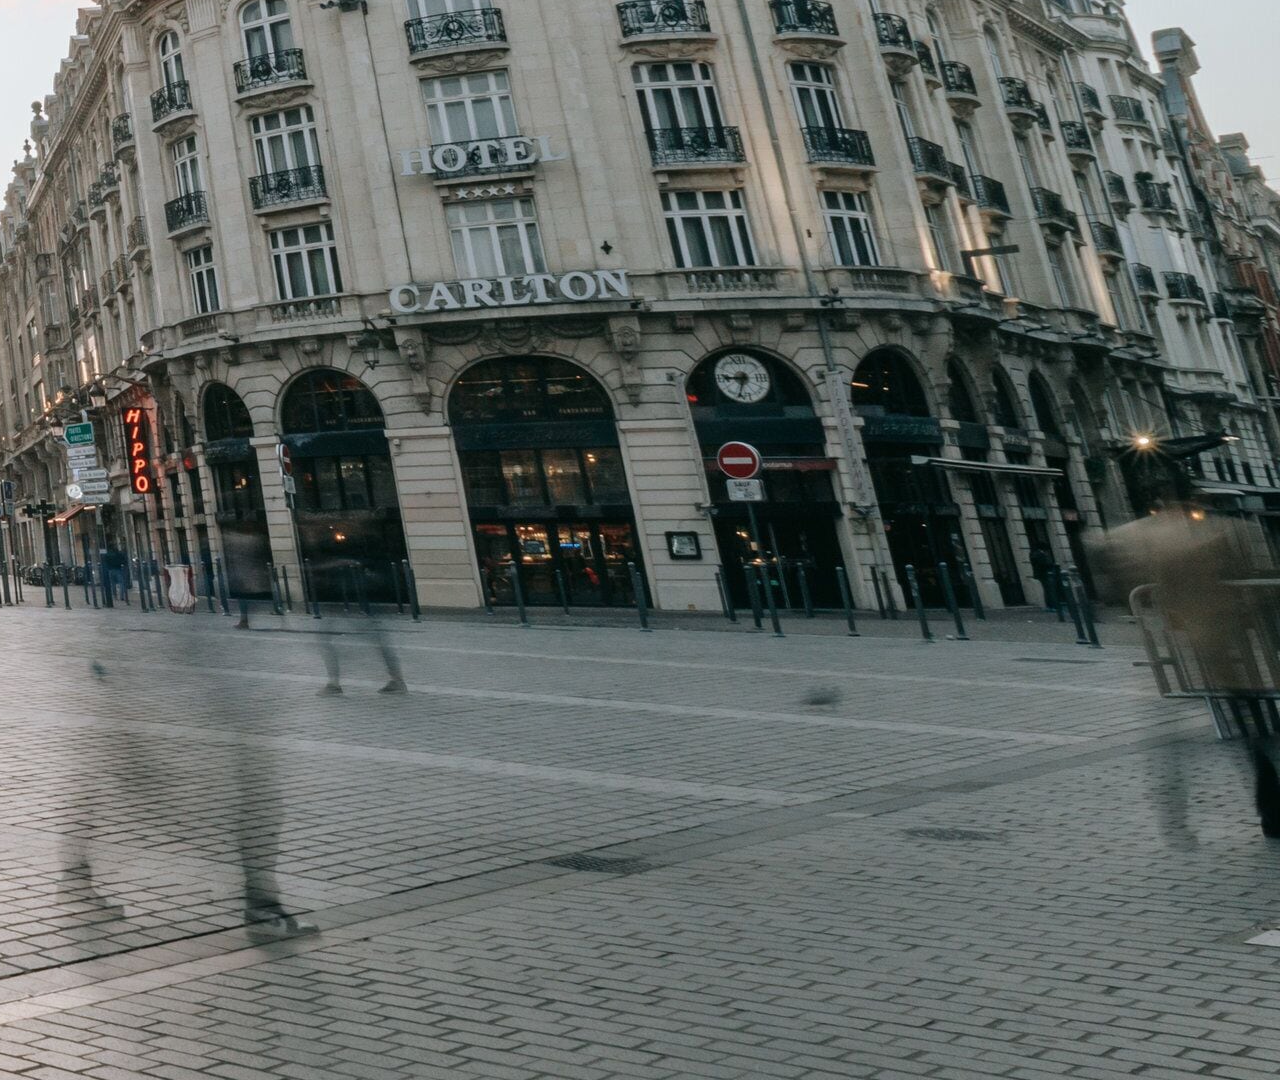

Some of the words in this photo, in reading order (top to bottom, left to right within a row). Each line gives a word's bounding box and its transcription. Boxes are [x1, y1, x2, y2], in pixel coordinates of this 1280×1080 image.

[400, 135, 567, 176] HOTEL
[389, 269, 629, 313] CARLTON
[126, 409, 149, 492] HIPPO
